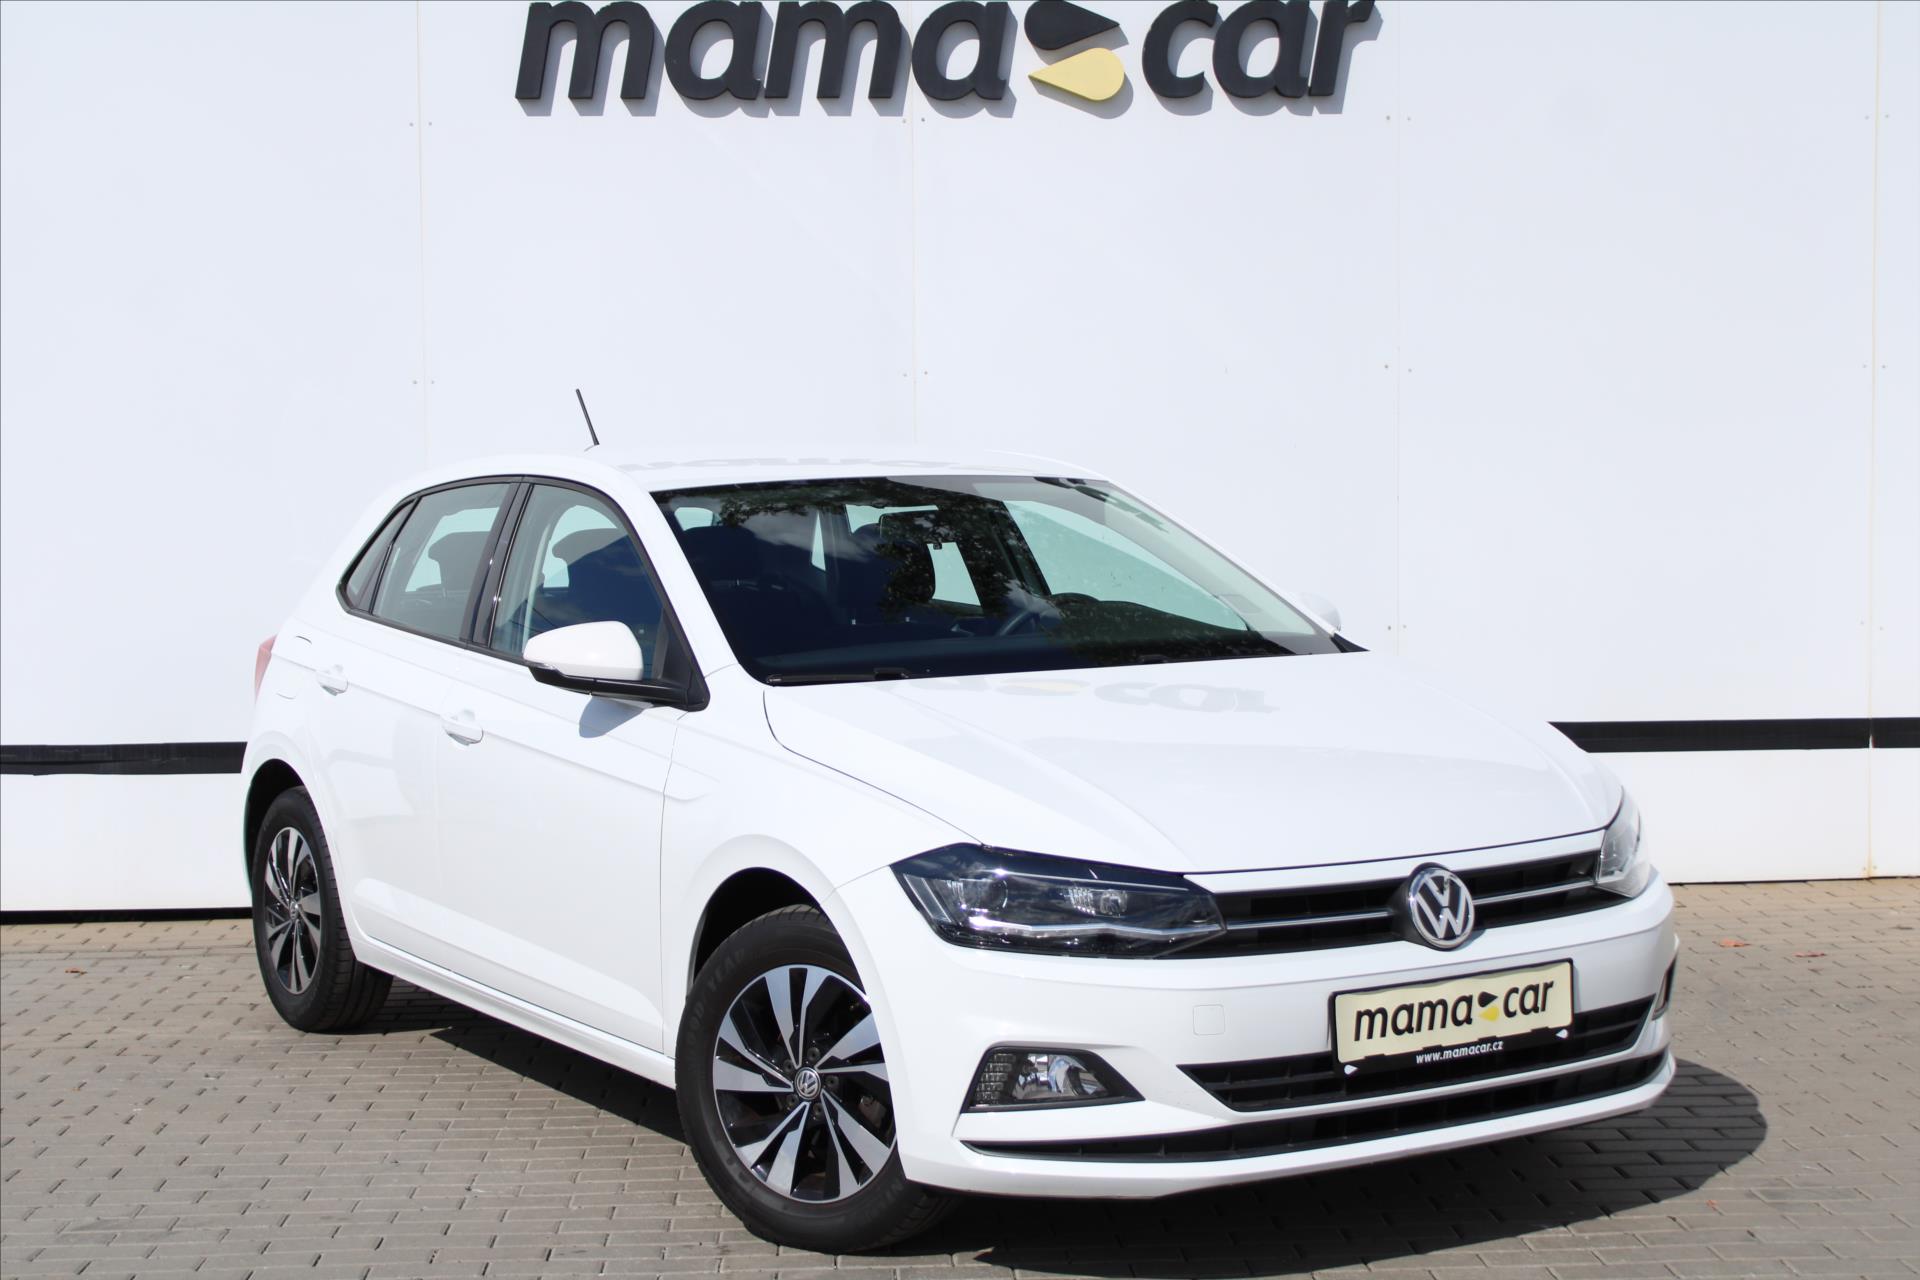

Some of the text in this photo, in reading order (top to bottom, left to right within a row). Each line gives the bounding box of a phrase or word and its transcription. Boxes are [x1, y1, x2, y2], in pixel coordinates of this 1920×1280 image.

[515, 0, 1375, 101] mama car
[1409, 867, 1474, 949] VW
[1354, 981, 1554, 1041] mama car
[1416, 1040, 1503, 1063] www.mamacar.cz
